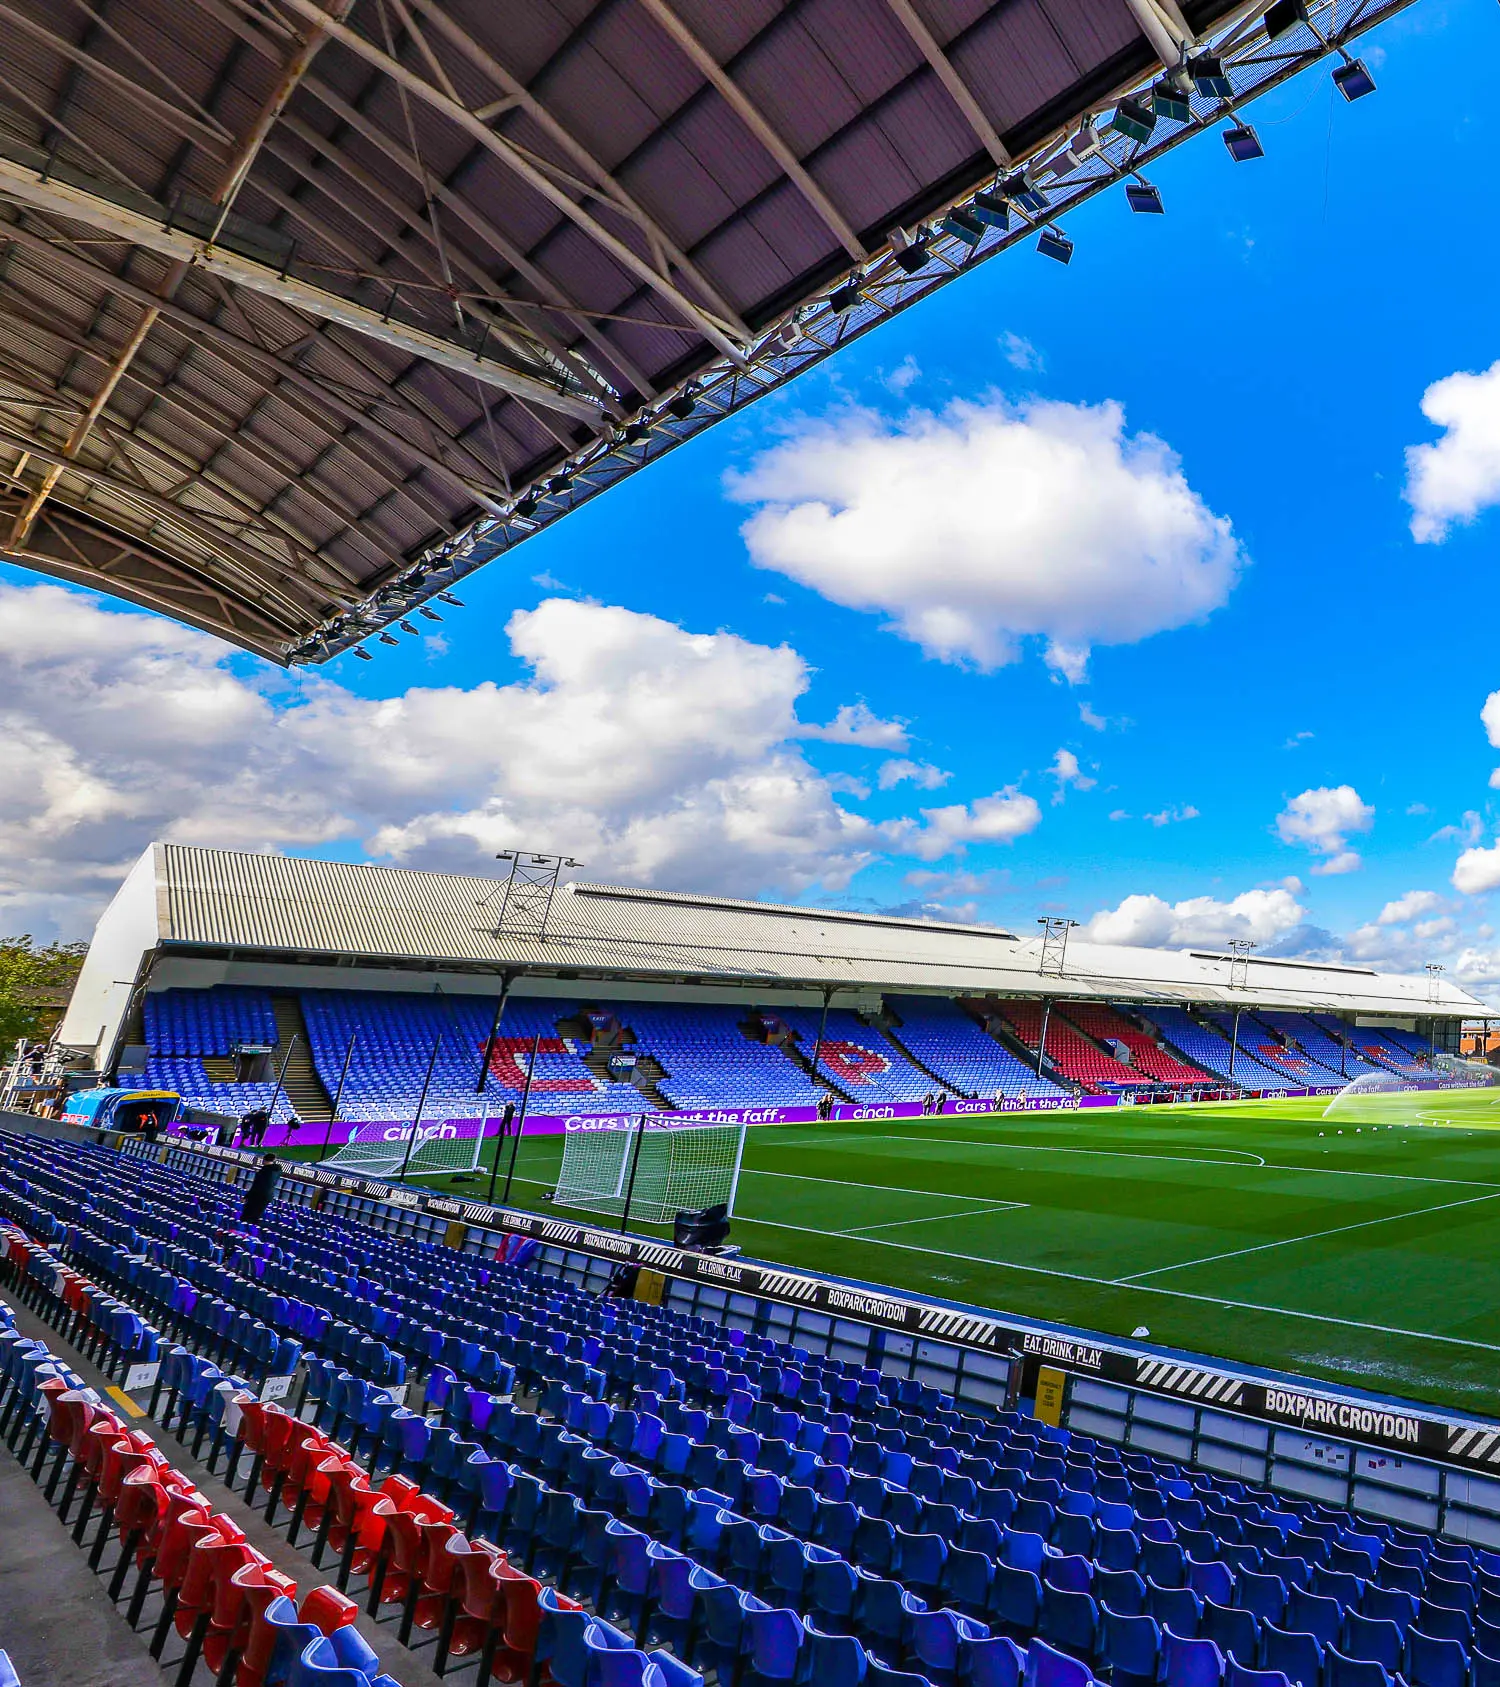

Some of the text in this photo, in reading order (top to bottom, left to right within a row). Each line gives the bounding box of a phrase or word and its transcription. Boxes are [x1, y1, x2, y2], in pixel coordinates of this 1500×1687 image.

[1315, 1087, 1331, 1096] Cars
[853, 1104, 894, 1119] cinch
[955, 1101, 986, 1113] Cars
[1039, 1098, 1058, 1109] the
[383, 1121, 457, 1141] cinch
[565, 1115, 618, 1131] Cars
[707, 1111, 740, 1124] the
[583, 1232, 632, 1255] BOXPARK CROYDON
[827, 1289, 907, 1323] BOXPARK CROYDON
[1023, 1334, 1042, 1352] EAT.
[1042, 1338, 1075, 1360] DRINK.
[1265, 1389, 1419, 1443] BOXPARK CROYDON
